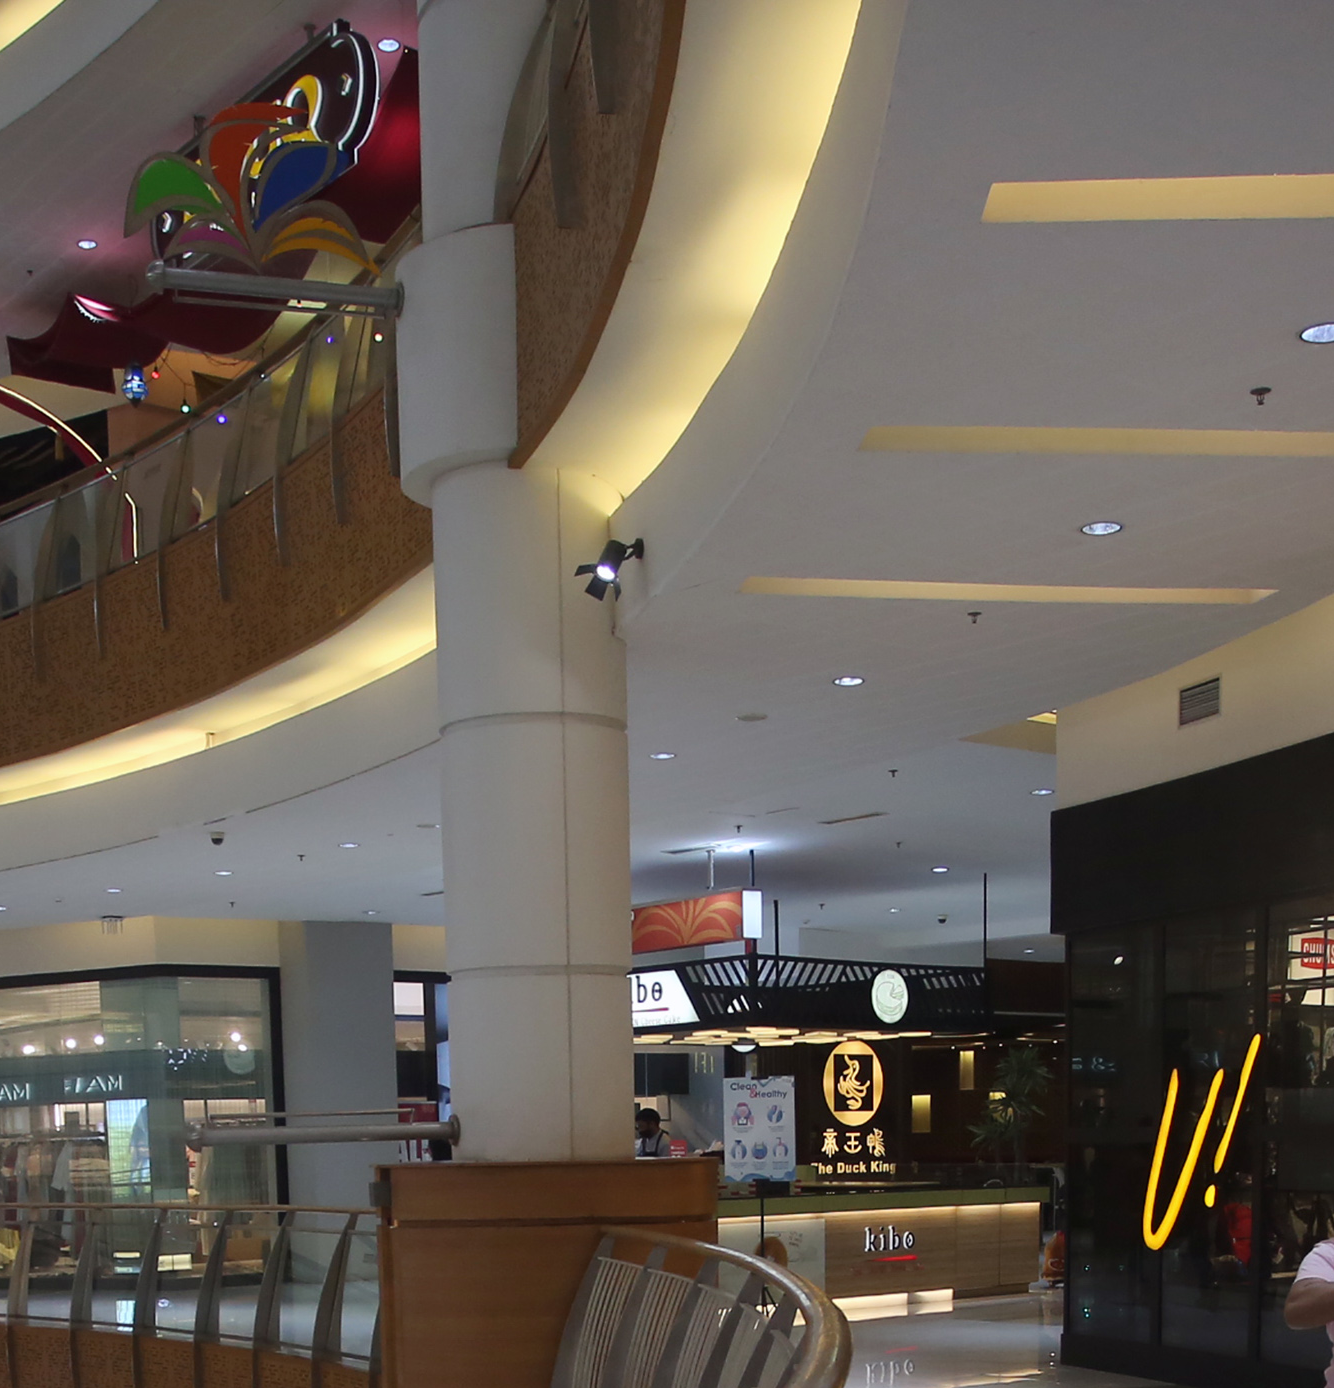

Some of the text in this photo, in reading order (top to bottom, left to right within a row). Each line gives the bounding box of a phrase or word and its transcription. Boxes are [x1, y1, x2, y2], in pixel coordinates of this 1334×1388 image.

[730, 1082, 758, 1091] Clean
[756, 1090, 788, 1099] Healthy
[837, 1162, 867, 1174] Duck
[870, 1161, 897, 1174] King
[864, 1225, 916, 1252] kibo
